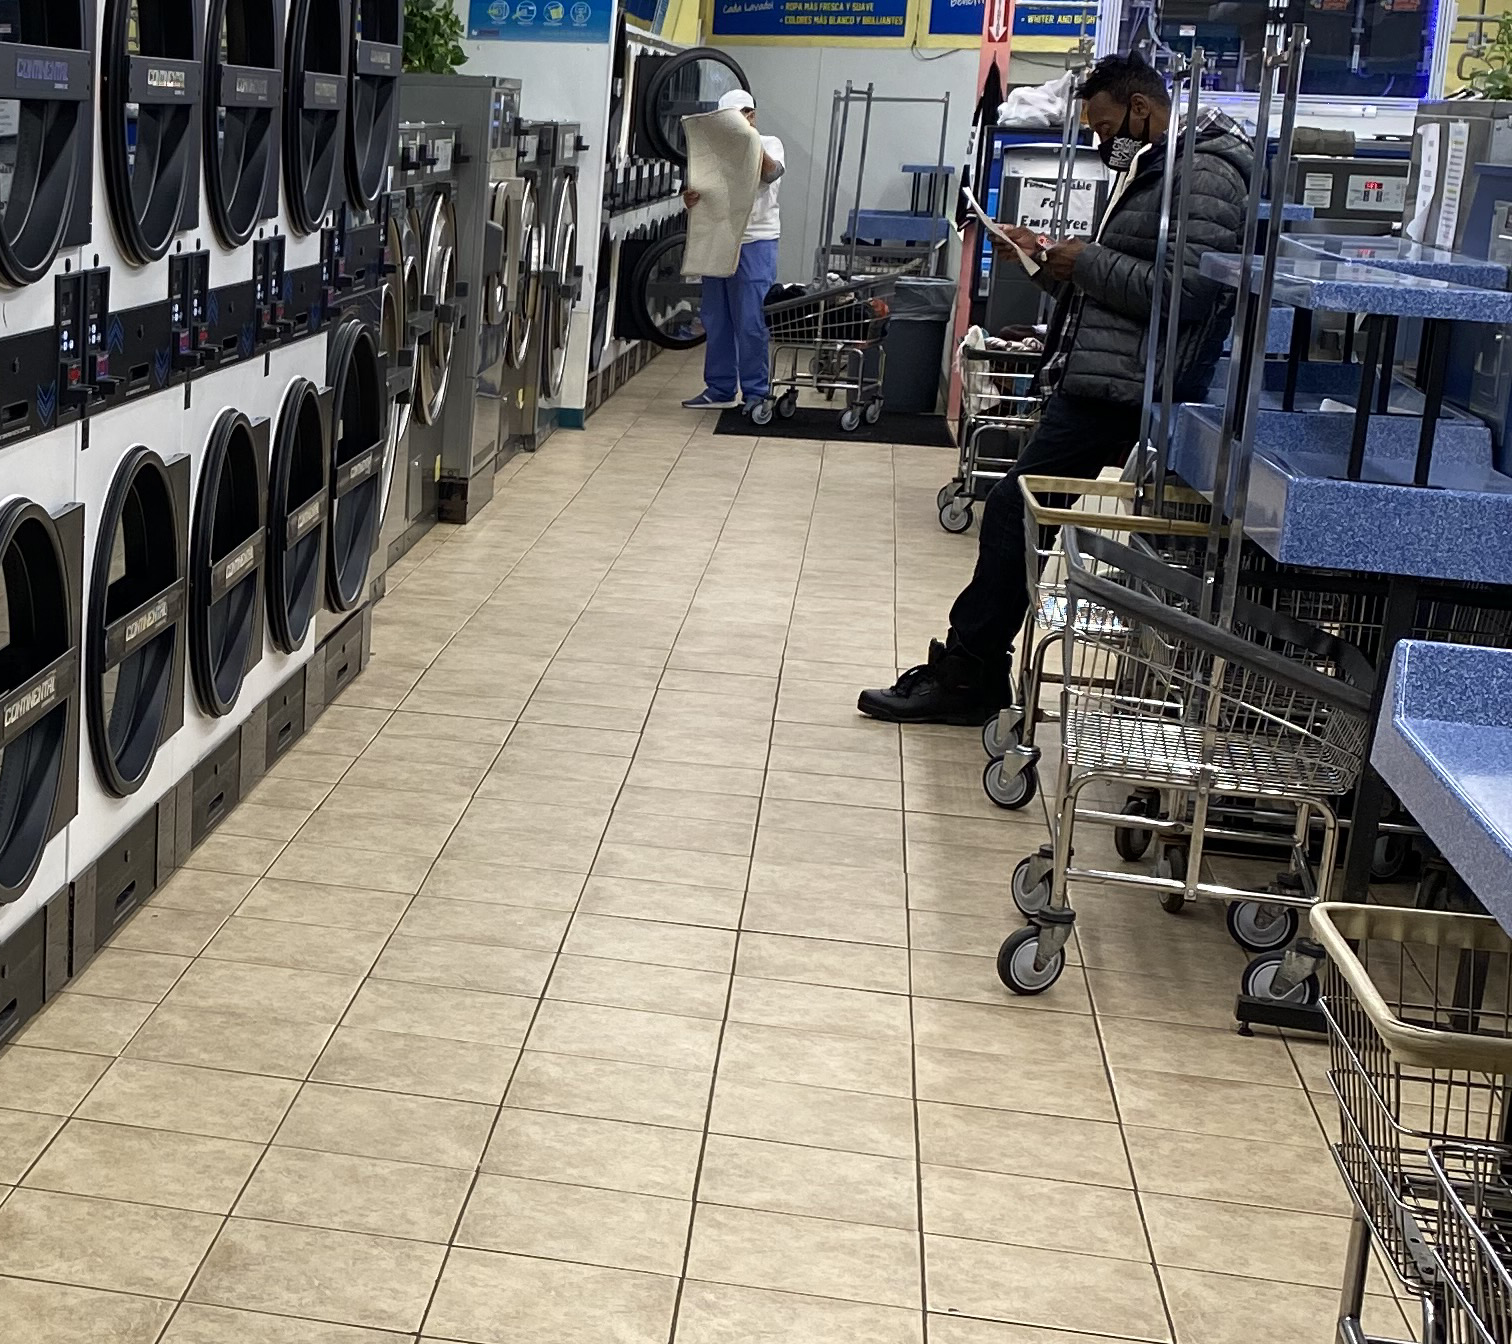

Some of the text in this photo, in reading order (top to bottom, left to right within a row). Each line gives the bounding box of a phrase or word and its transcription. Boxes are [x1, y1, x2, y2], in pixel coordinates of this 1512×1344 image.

[1027, 15, 1054, 24] WHITER
[1108, 135, 1126, 166] BLACK
[124, 601, 168, 642] CONTINENTAL
[4, 675, 56, 727] CONTINENTAL
